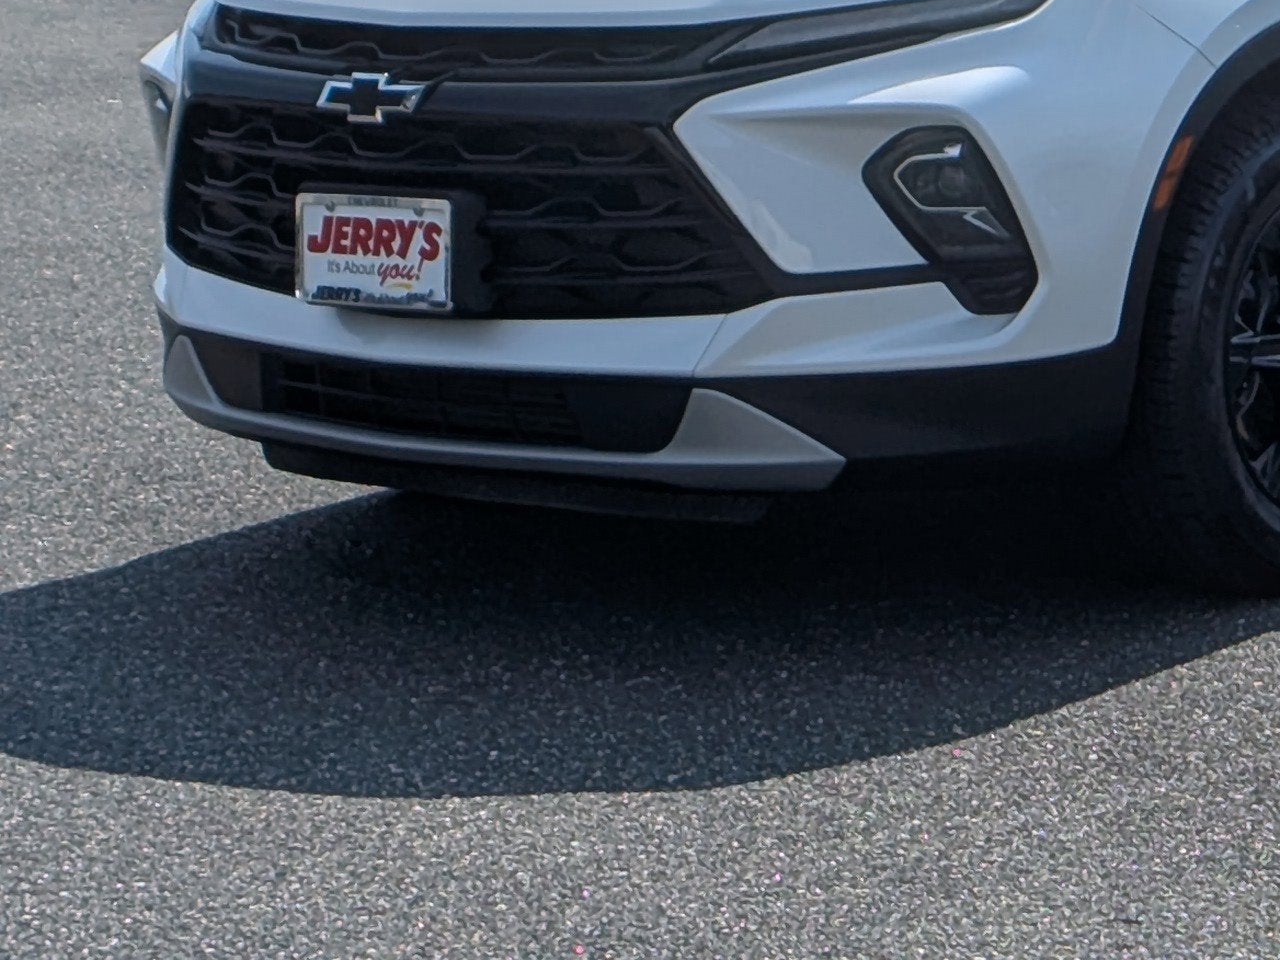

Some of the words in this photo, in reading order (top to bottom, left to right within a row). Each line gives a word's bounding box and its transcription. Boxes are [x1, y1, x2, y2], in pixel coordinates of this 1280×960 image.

[307, 215, 443, 262] JERRY'S
[327, 259, 341, 273] It's
[343, 261, 375, 274] About
[377, 258, 424, 287] you!
